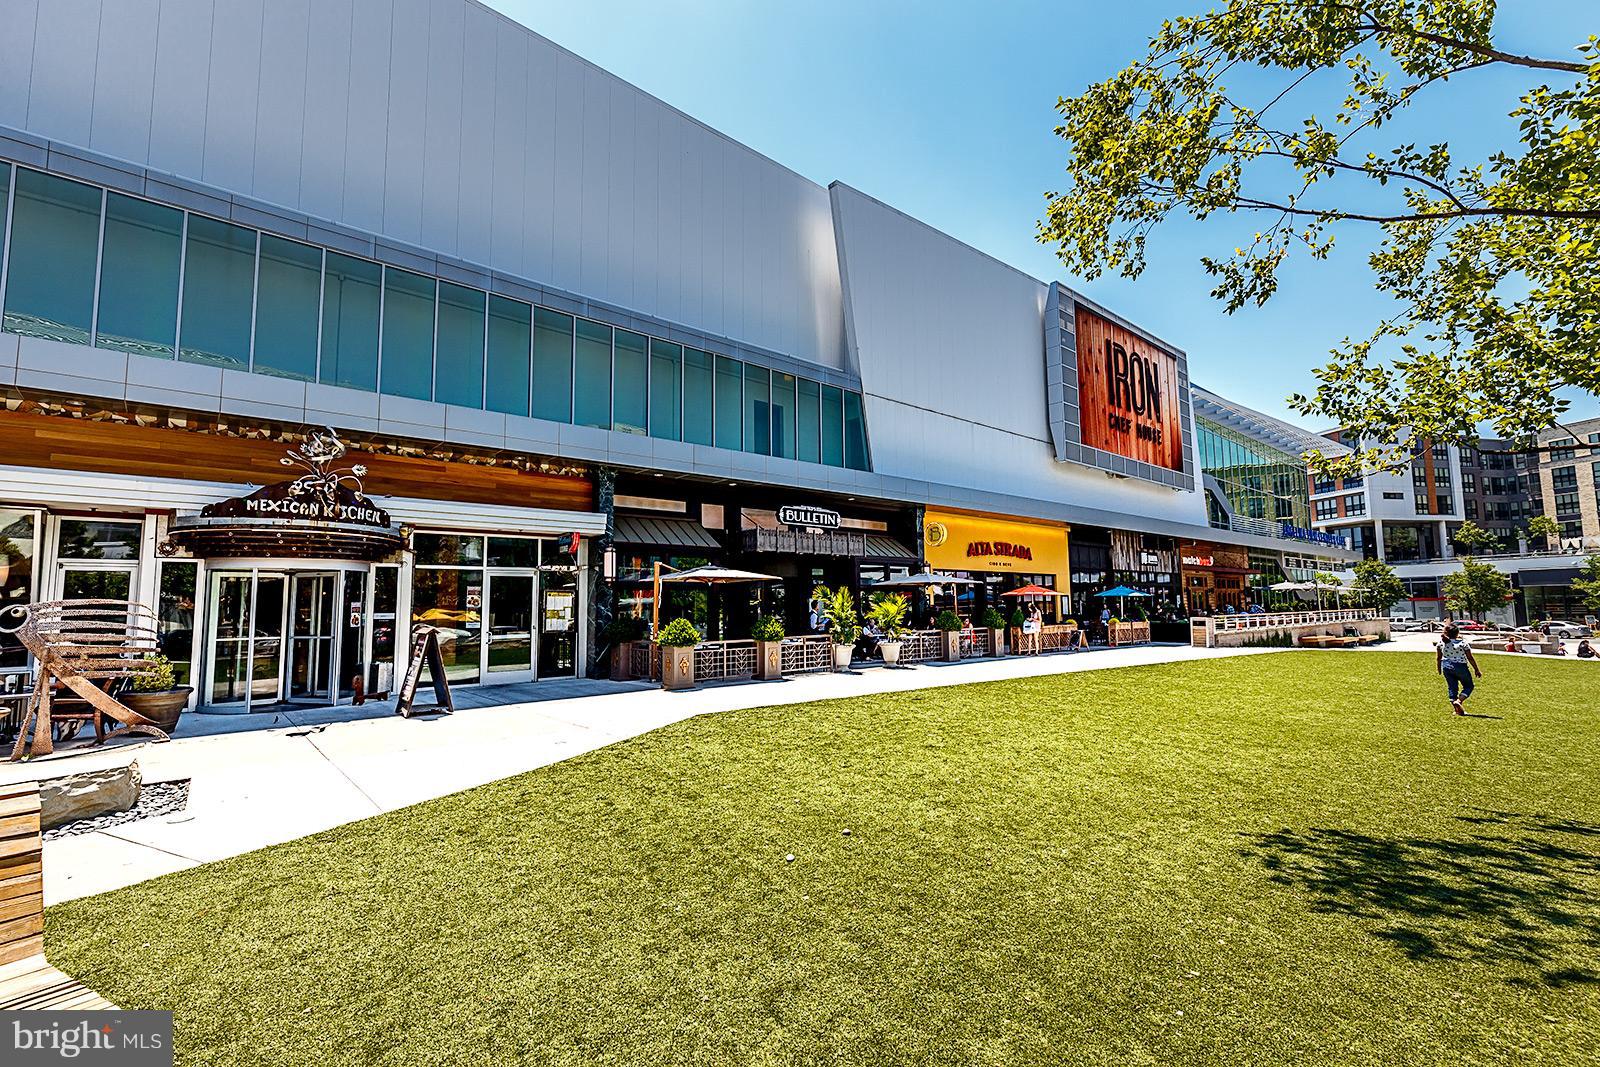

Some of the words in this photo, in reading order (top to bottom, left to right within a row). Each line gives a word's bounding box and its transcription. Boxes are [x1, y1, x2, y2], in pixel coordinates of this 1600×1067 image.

[1105, 339, 1161, 423] IRON
[1108, 412, 1132, 435] CHEF
[1136, 422, 1163, 446] HOUSE
[246, 499, 319, 515] MEXICAN
[323, 504, 380, 523] KTCHEN
[785, 509, 836, 525] BULLETIN
[967, 541, 993, 557] ALTA
[993, 541, 1032, 561] STRADA
